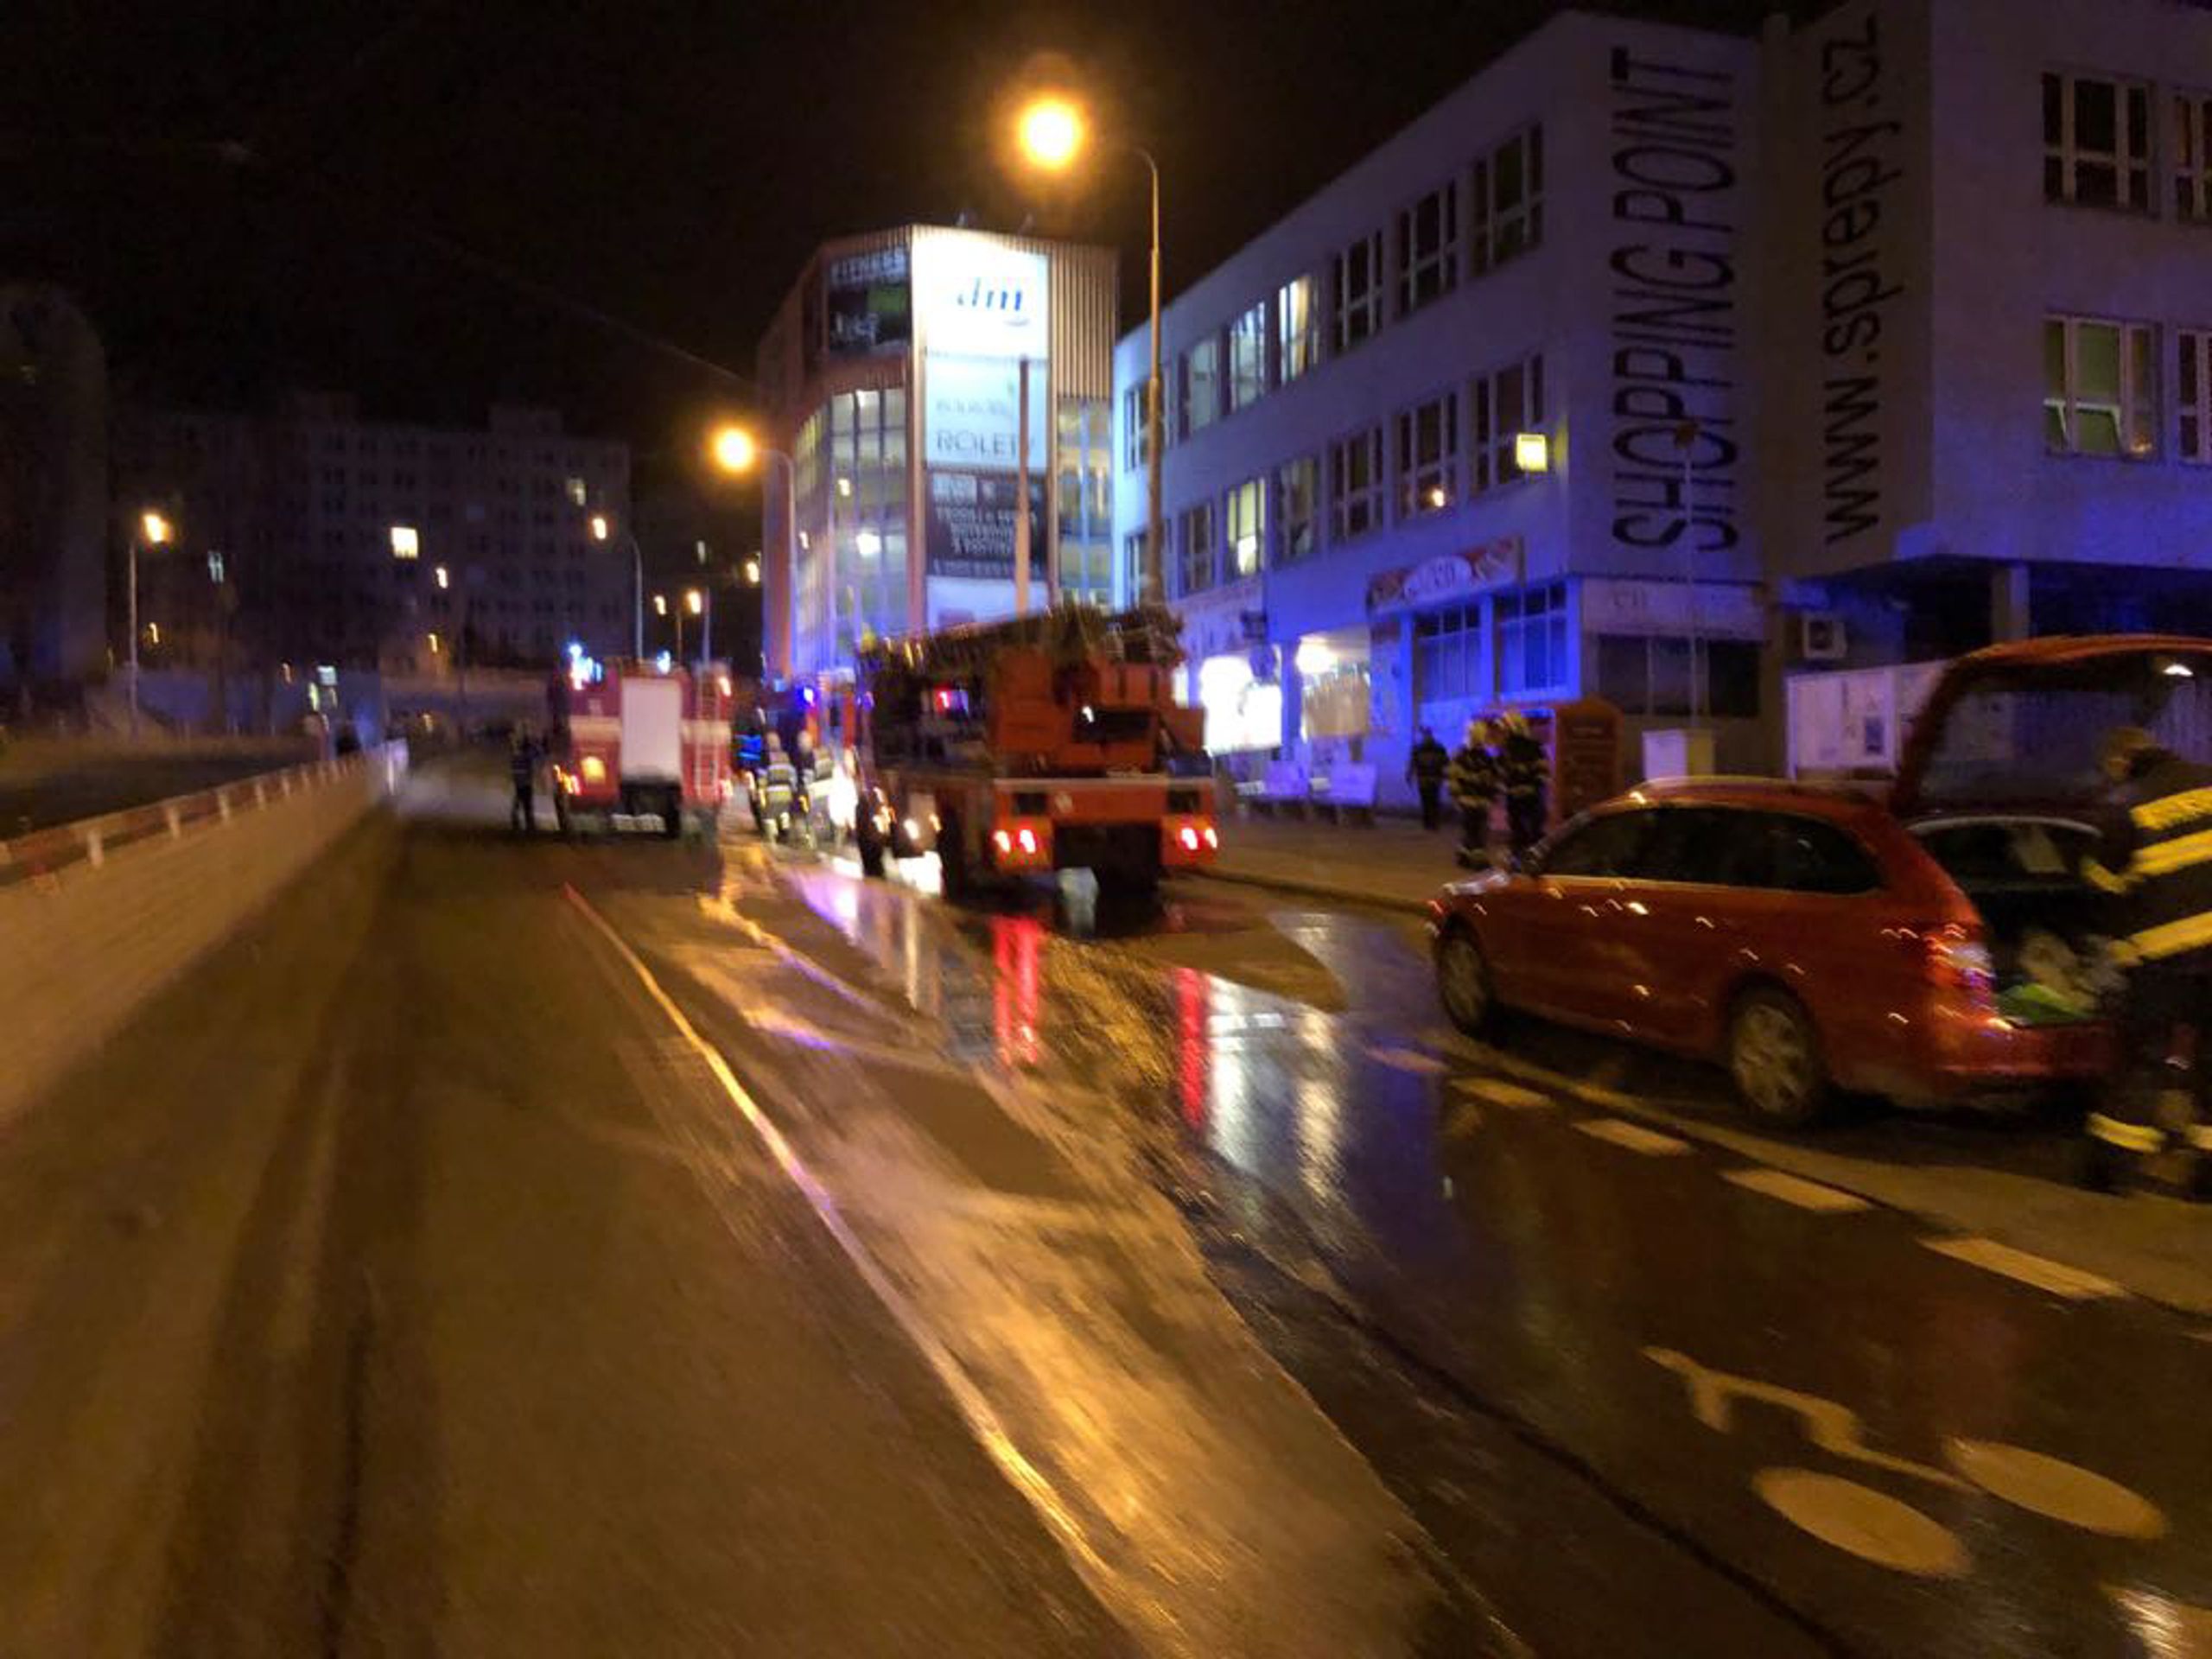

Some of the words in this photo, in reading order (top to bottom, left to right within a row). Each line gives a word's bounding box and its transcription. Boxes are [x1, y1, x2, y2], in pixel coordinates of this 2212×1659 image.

[1610, 46, 1737, 233] POINT
[957, 276, 1024, 312] dm
[1609, 245, 1738, 553] SHOPPING
[1821, 15, 1904, 546] www.sprepy.cz
